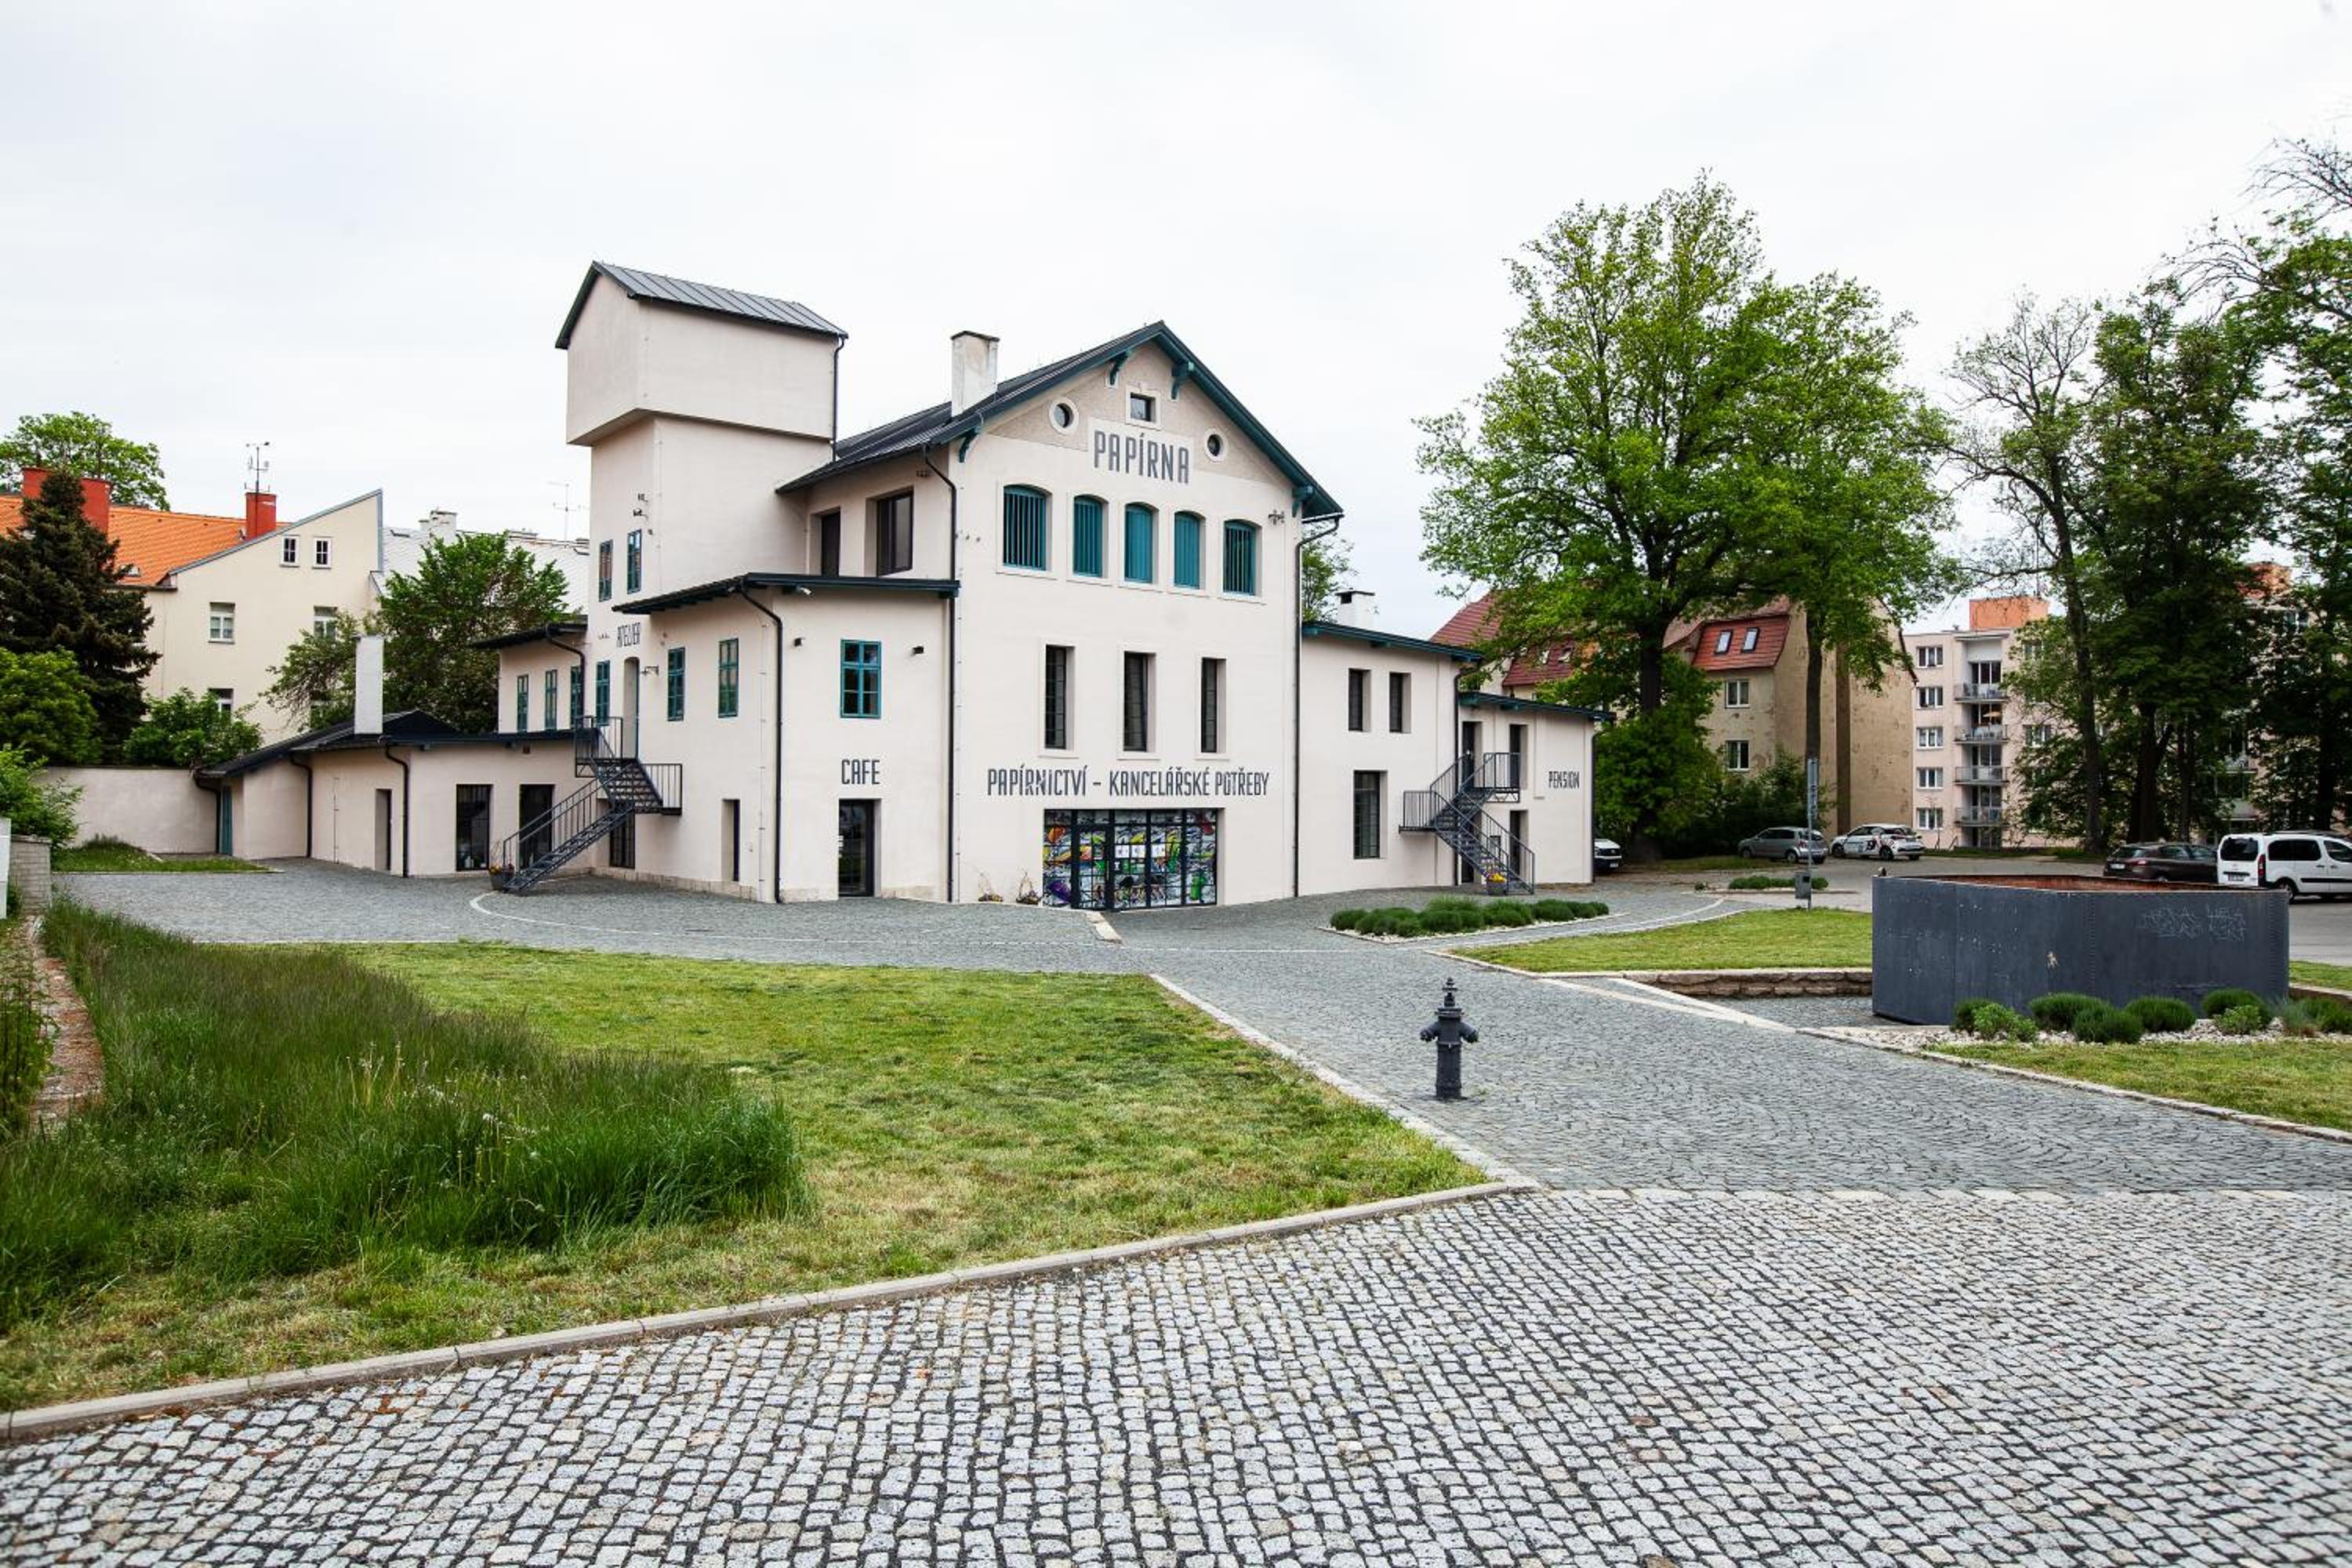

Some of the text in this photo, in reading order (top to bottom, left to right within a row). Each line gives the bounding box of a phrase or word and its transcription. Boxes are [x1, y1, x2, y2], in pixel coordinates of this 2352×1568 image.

[1094, 430, 1189, 485] PAPÍRNA
[841, 759, 880, 785] CAFE
[987, 764, 1087, 796] PAPÍRNICTVÍ
[1109, 766, 1210, 796] KANCELÁŘSKÉ
[1215, 768, 1269, 796] POTŘEBY
[1548, 771, 1580, 789] PENSION
